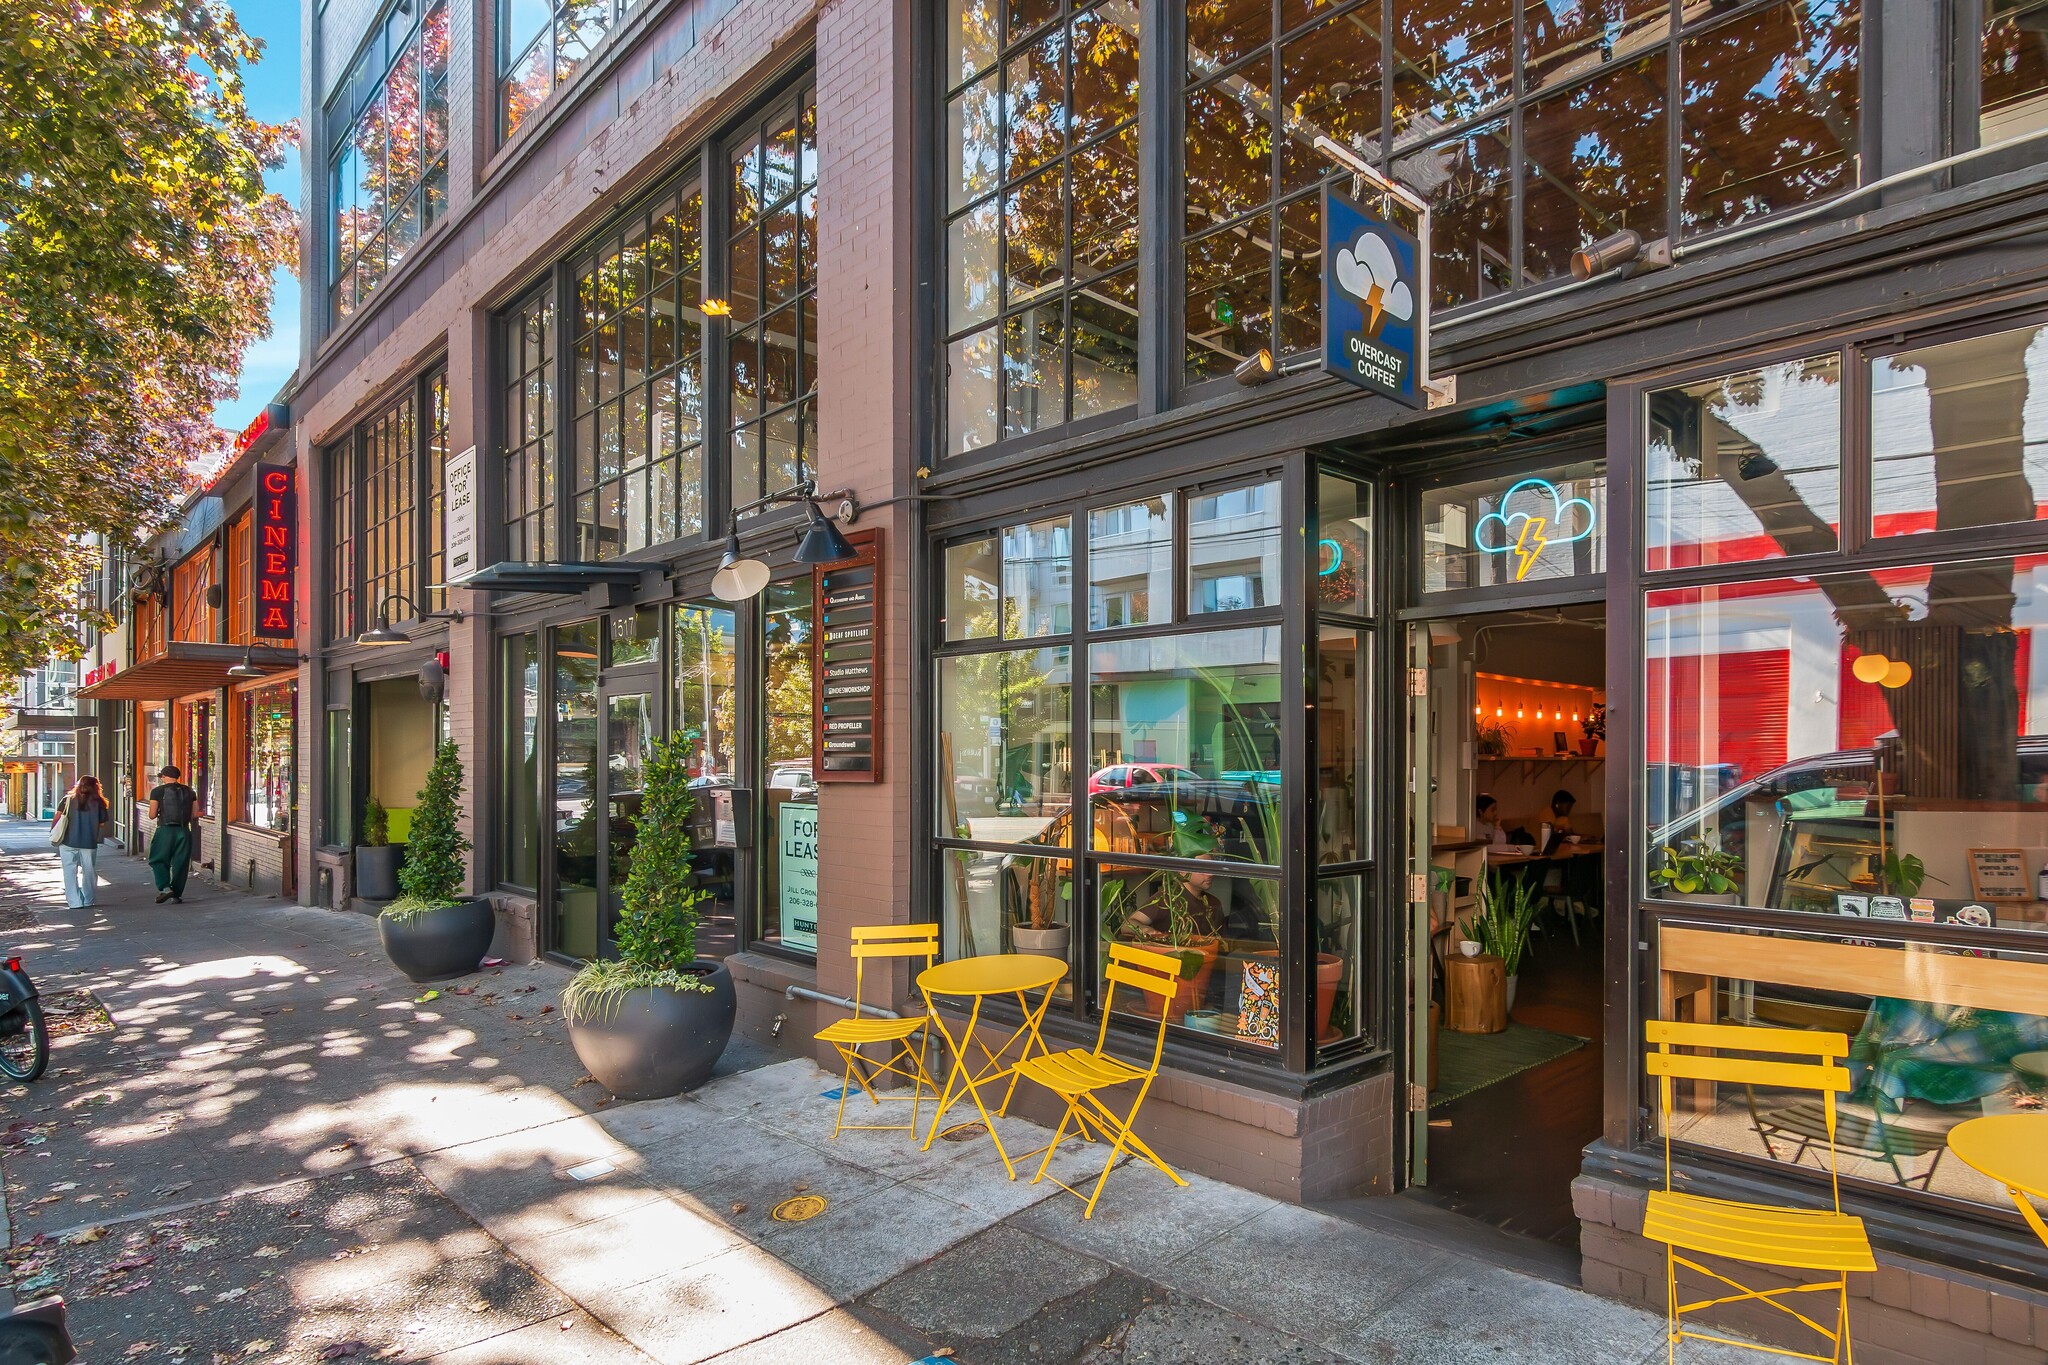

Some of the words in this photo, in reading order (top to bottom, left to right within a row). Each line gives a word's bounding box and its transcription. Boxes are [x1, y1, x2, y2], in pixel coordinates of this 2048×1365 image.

[1350, 337, 1402, 373] OVERCAST
[1357, 359, 1396, 389] COFFEE
[450, 461, 472, 483] OFFICE
[454, 480, 467, 495] FOR
[451, 492, 471, 511] LEASE
[261, 471, 289, 629] CINEMA
[612, 616, 634, 637] 1517
[845, 629, 869, 638] SPOTLIGHT
[829, 669, 844, 677] Studio
[845, 667, 868, 675] Matthews
[785, 840, 818, 860] LEAS
[787, 885, 799, 894] JILL
[800, 887, 817, 896] CRON
